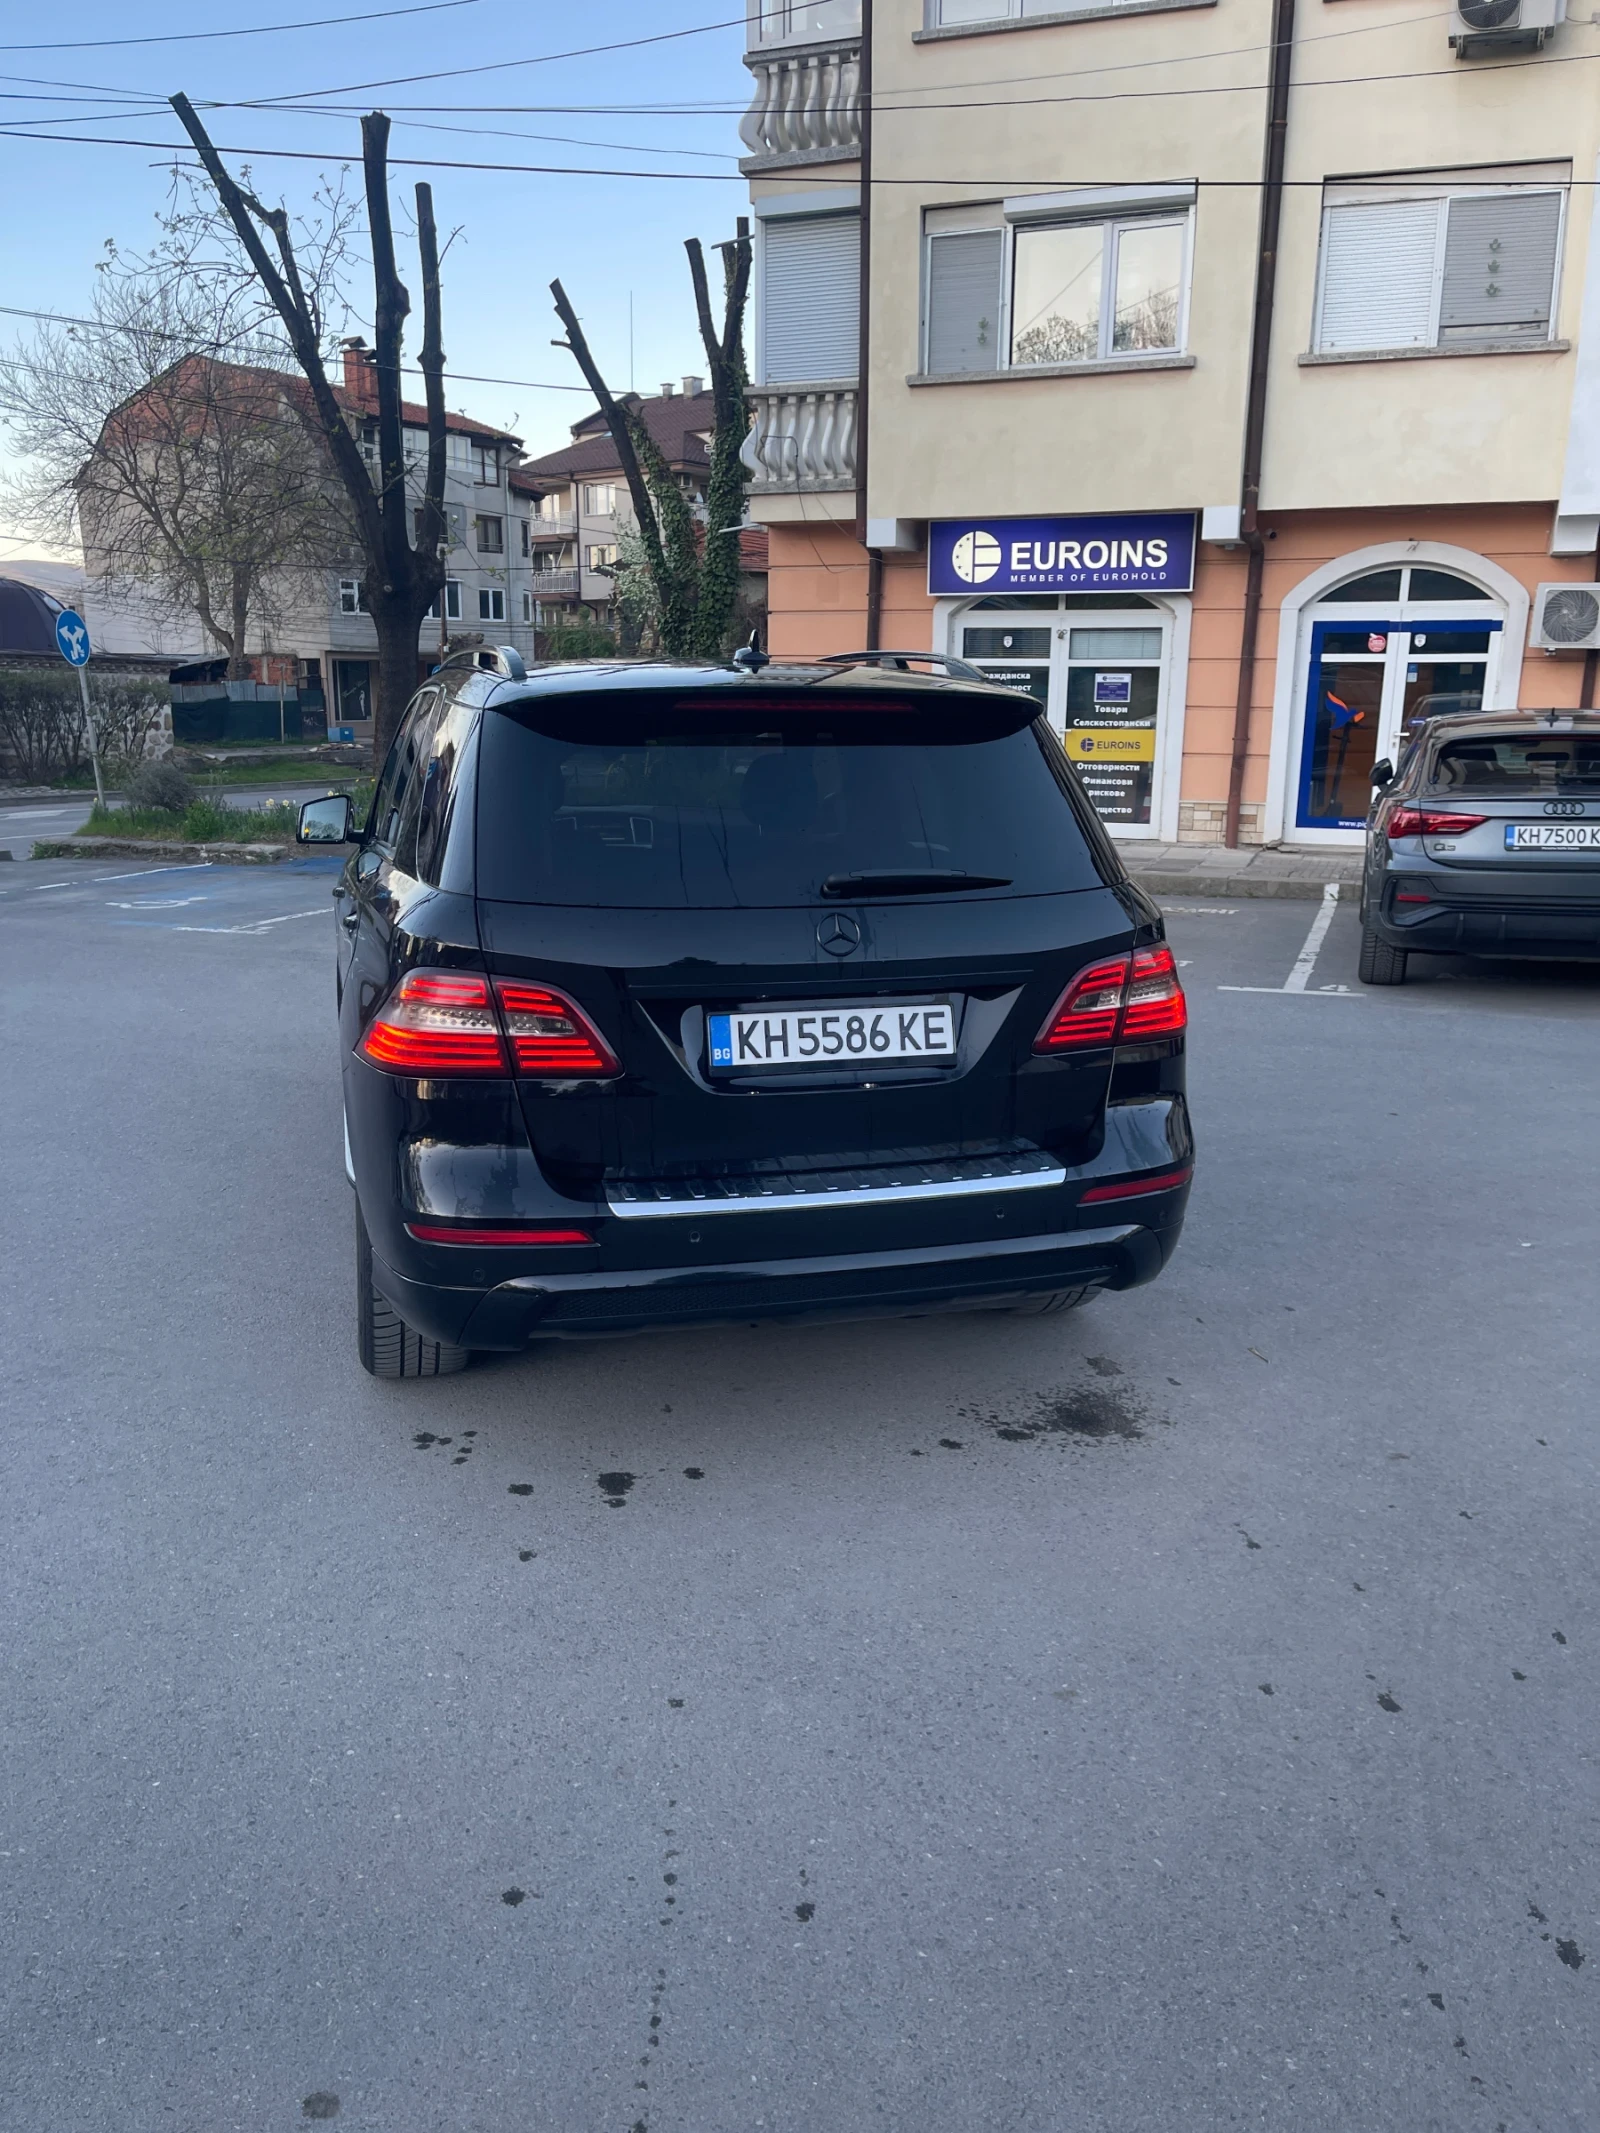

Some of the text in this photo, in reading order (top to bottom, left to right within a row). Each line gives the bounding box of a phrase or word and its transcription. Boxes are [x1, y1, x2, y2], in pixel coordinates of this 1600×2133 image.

[1010, 539, 1168, 570] EUROINS
[1010, 572, 1167, 582] MEMBER OF EUROHOLD
[1094, 705, 1128, 715] Товари
[1073, 718, 1151, 727] Селскостопански
[1097, 741, 1141, 750] EUROINS
[1076, 762, 1140, 772] Отговорности
[1082, 776, 1133, 786] Финансови
[1517, 828, 1540, 844] KH
[1544, 828, 1586, 844] 7500
[737, 1011, 947, 1059] KH 5586 KE
[713, 1048, 731, 1060] BG
